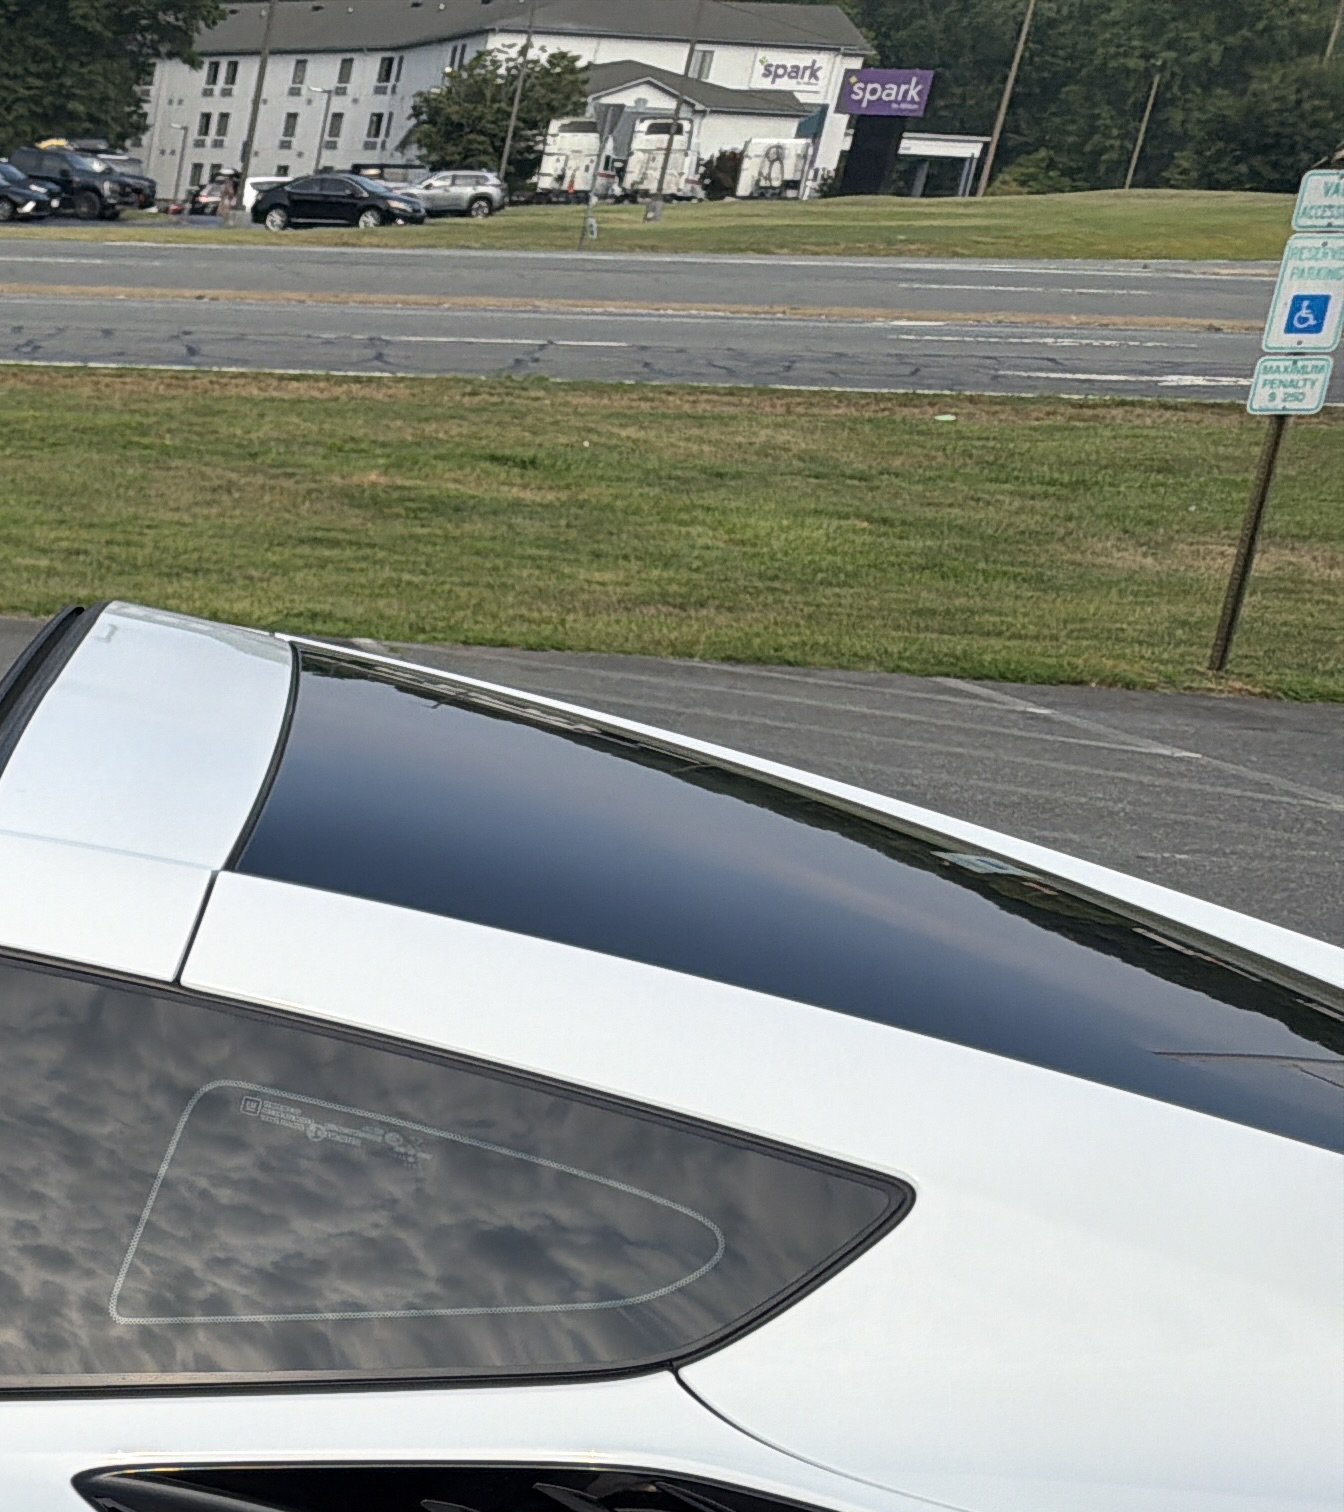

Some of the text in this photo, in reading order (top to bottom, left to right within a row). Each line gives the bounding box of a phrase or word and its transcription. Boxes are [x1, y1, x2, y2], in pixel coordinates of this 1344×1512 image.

[762, 59, 823, 84] spark
[851, 76, 923, 107] spark
[1323, 181, 1344, 197] VA
[1262, 379, 1317, 389] PENALTY
